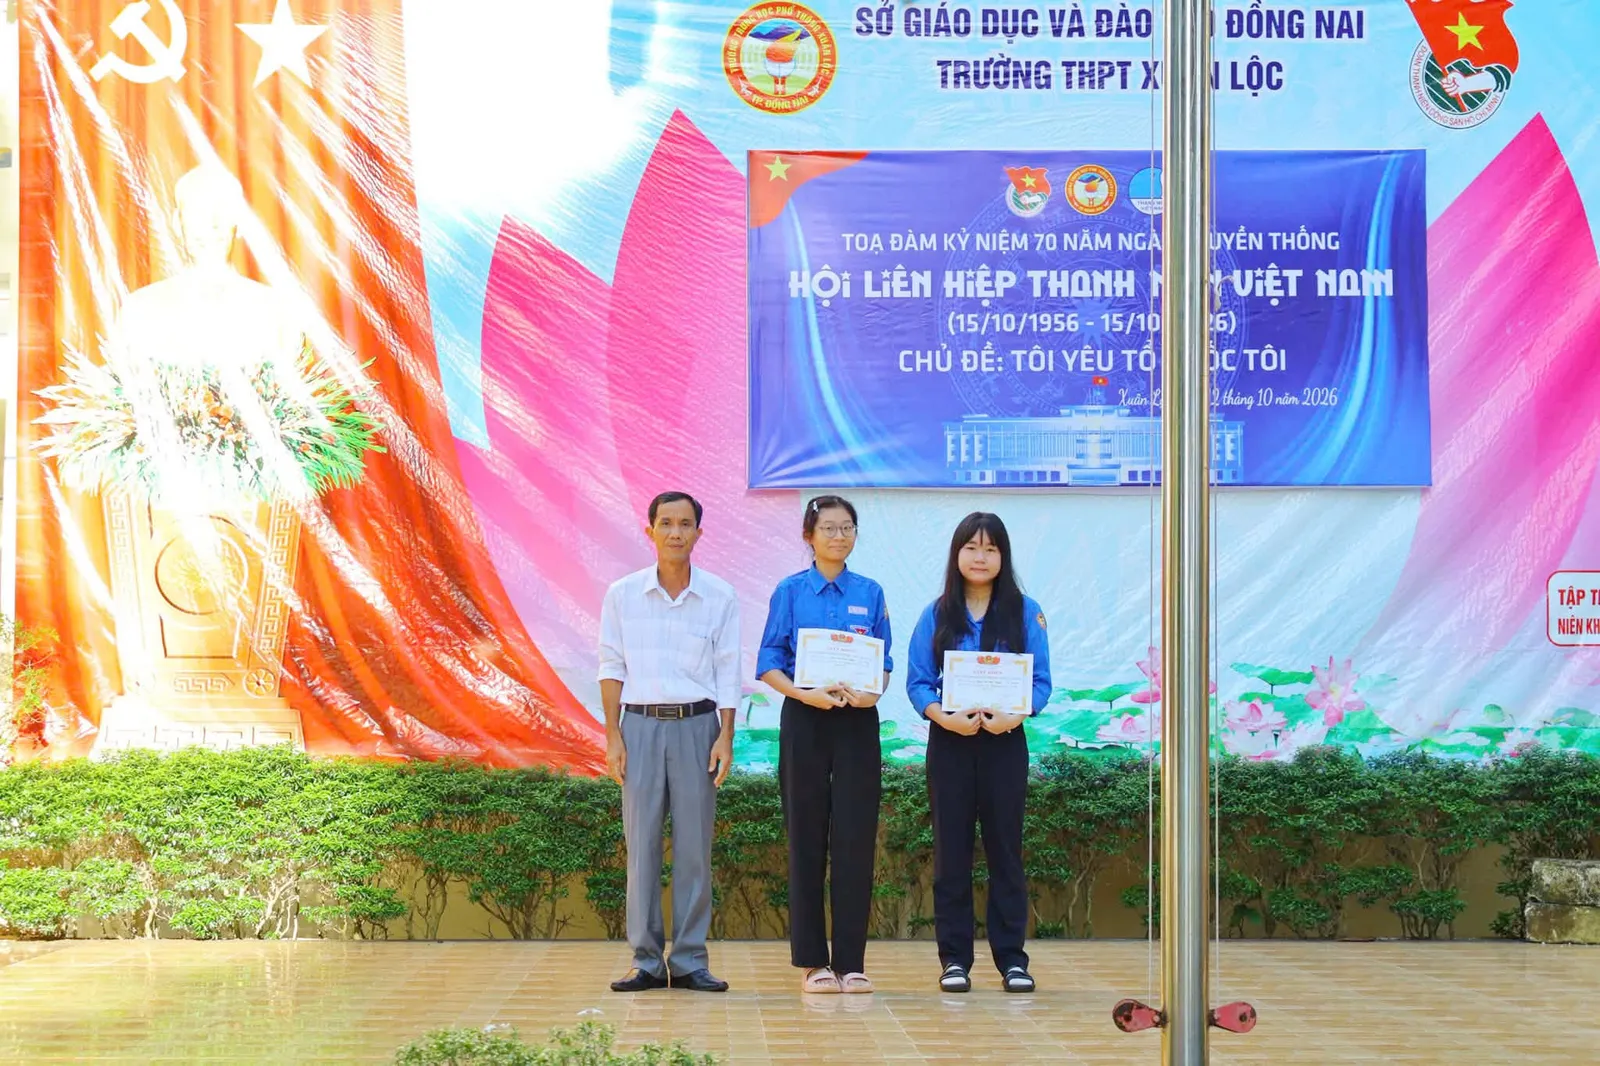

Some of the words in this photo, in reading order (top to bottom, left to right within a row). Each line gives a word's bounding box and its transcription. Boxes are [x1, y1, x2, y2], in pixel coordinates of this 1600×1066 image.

[855, 0, 894, 36] SỞ
[904, 2, 971, 37] GIÁO
[982, 8, 1038, 44] DỤC
[1049, 3, 1085, 38] VÀ
[1095, 3, 1152, 38] ĐÀO
[1225, 0, 1304, 38] ĐỒNG
[1315, 10, 1364, 39] NAI
[937, 53, 1052, 90] TRƯỜNG
[1061, 60, 1132, 90] THPT
[1230, 55, 1283, 97] LỘC
[842, 233, 884, 255] TOẠ
[889, 229, 937, 251] ĐÀM
[943, 227, 970, 251] KỶ
[976, 229, 1028, 255] NIỆM
[1034, 233, 1057, 251] 70
[1063, 229, 1112, 251] NĂM
[1118, 228, 1162, 251] NGÀ
[1268, 225, 1340, 251] THỐNG
[1027, 269, 1135, 298] THANH
[1315, 268, 1393, 297] NAM
[948, 311, 1079, 335] (15/10/1956
[899, 343, 952, 372] CHỦ
[960, 341, 1004, 372] ĐỀ:
[1011, 344, 1054, 372] TÔI
[1061, 344, 1114, 372] YÊU
[1121, 339, 1156, 372] TỔ
[1243, 343, 1286, 372] TÔI
[1118, 387, 1148, 406] Xuân
[1222, 388, 1254, 410] tháng
[1257, 387, 1273, 406] 10
[1275, 392, 1299, 405] năm
[1301, 387, 1338, 406] 2026
[1558, 585, 1586, 610] TẬP
[1558, 614, 1584, 635] NIÊN
